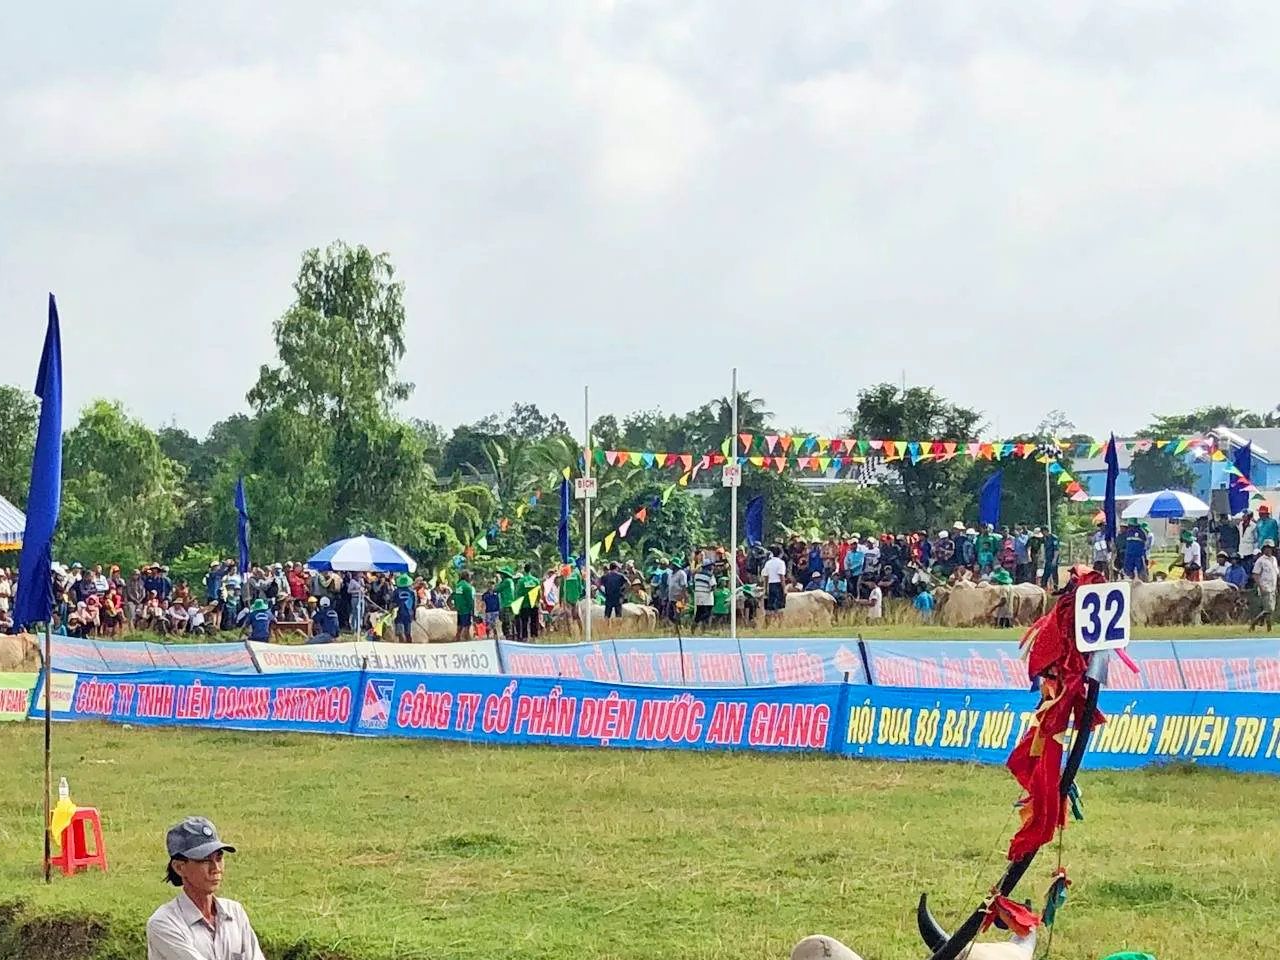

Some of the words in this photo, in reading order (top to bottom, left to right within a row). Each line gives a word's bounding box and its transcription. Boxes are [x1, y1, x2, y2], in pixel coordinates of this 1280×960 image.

[1081, 589, 1125, 645] 32
[75, 676, 116, 715] CÔNG
[117, 683, 135, 716] TY
[136, 684, 176, 718] TNHH
[175, 678, 214, 719] LIÊN
[397, 683, 453, 729] CÔNG
[455, 692, 482, 732] TY
[482, 679, 518, 734] CỔ
[513, 684, 577, 737] PHẦN
[577, 690, 635, 746] ĐIỆN
[637, 692, 706, 742] NƯỚC
[707, 701, 746, 744] AN
[749, 702, 830, 749] GIANG
[847, 698, 877, 753] HỘI
[877, 706, 913, 746] ĐUA
[940, 695, 980, 748] BẢY
[977, 703, 1016, 749] NÚI
[1088, 700, 1158, 754] THỐNG
[1228, 716, 1267, 758] TRI
